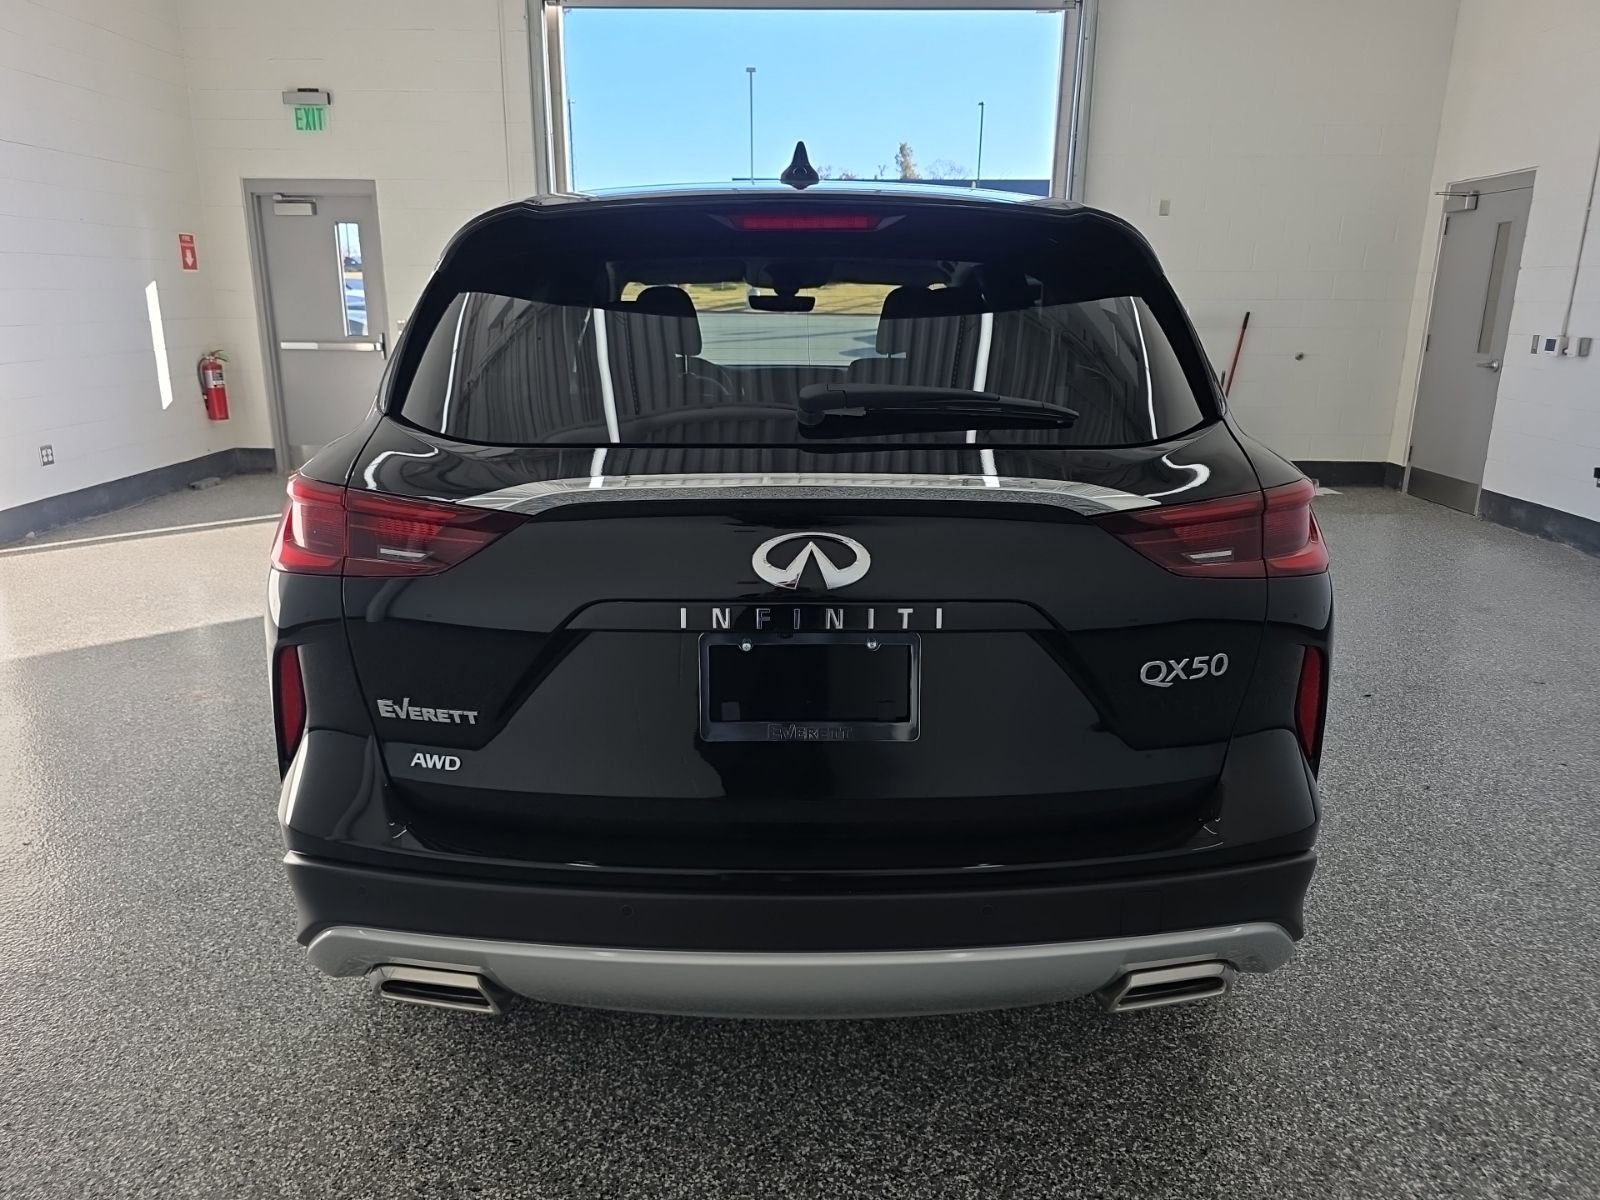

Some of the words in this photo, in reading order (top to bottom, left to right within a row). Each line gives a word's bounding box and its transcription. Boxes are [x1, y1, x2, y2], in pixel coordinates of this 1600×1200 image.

[295, 107, 323, 131] EXIT
[680, 607, 943, 630] INFINITI
[1140, 653, 1229, 688] QX50
[377, 697, 479, 725] EVERETT
[410, 752, 461, 771] AWD
